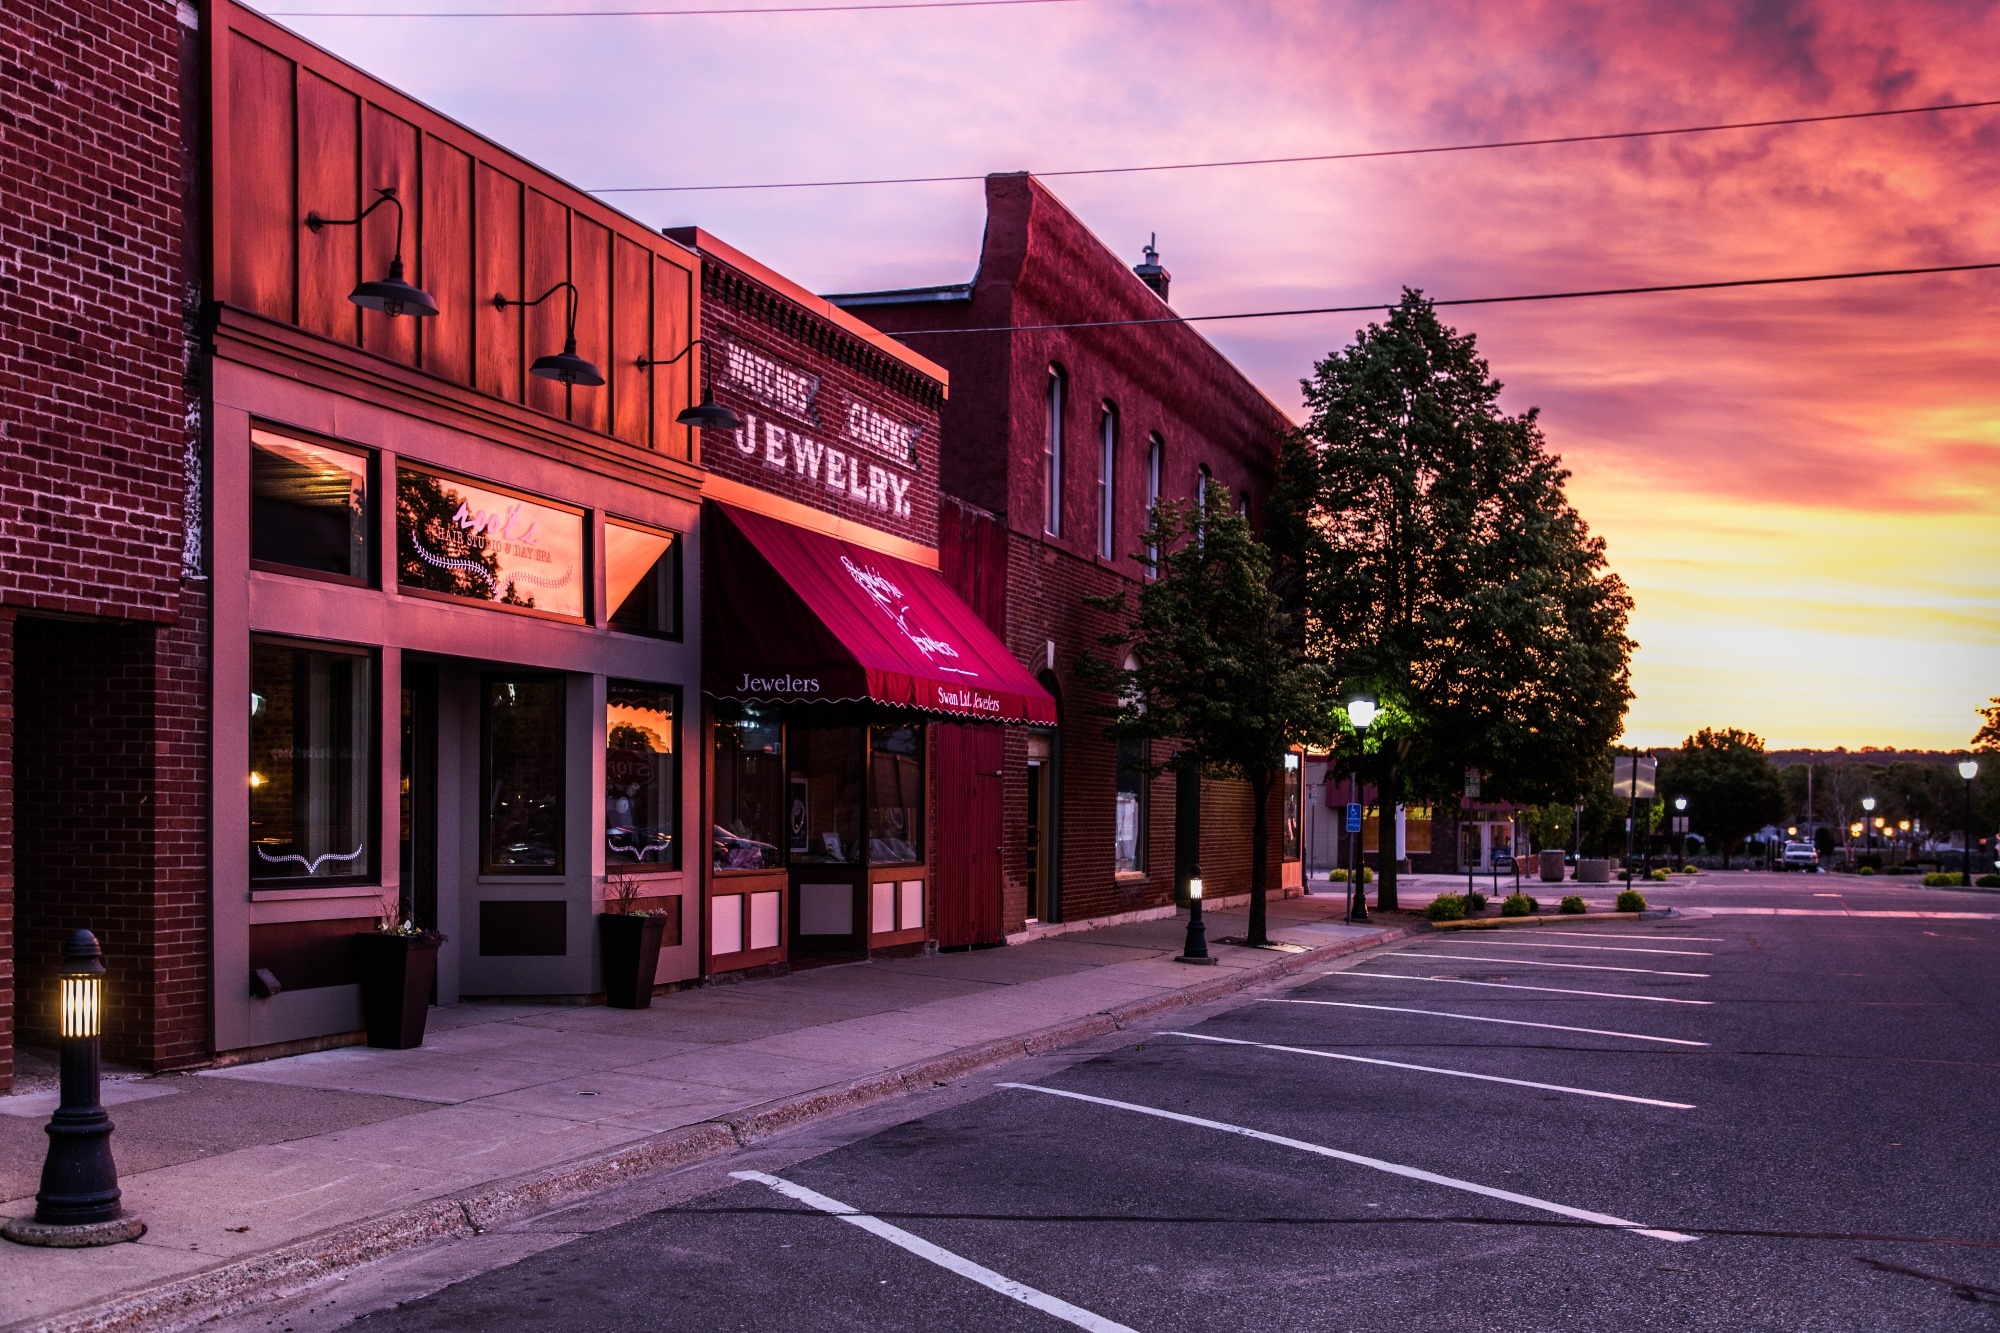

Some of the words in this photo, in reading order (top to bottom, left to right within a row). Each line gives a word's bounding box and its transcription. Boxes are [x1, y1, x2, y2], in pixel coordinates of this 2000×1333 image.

[727, 342, 808, 414] WATCHES
[848, 402, 910, 462] CLOCKS
[452, 501, 540, 546] roots
[438, 527, 464, 545] HAIR
[466, 532, 502, 553] STUDIO
[505, 544, 513, 555] &
[514, 543, 534, 561] DAY
[534, 548, 553, 564] SPA
[736, 673, 820, 692] Jewelers
[938, 686, 958, 706] Swan
[973, 692, 1000, 712] Jewelers
